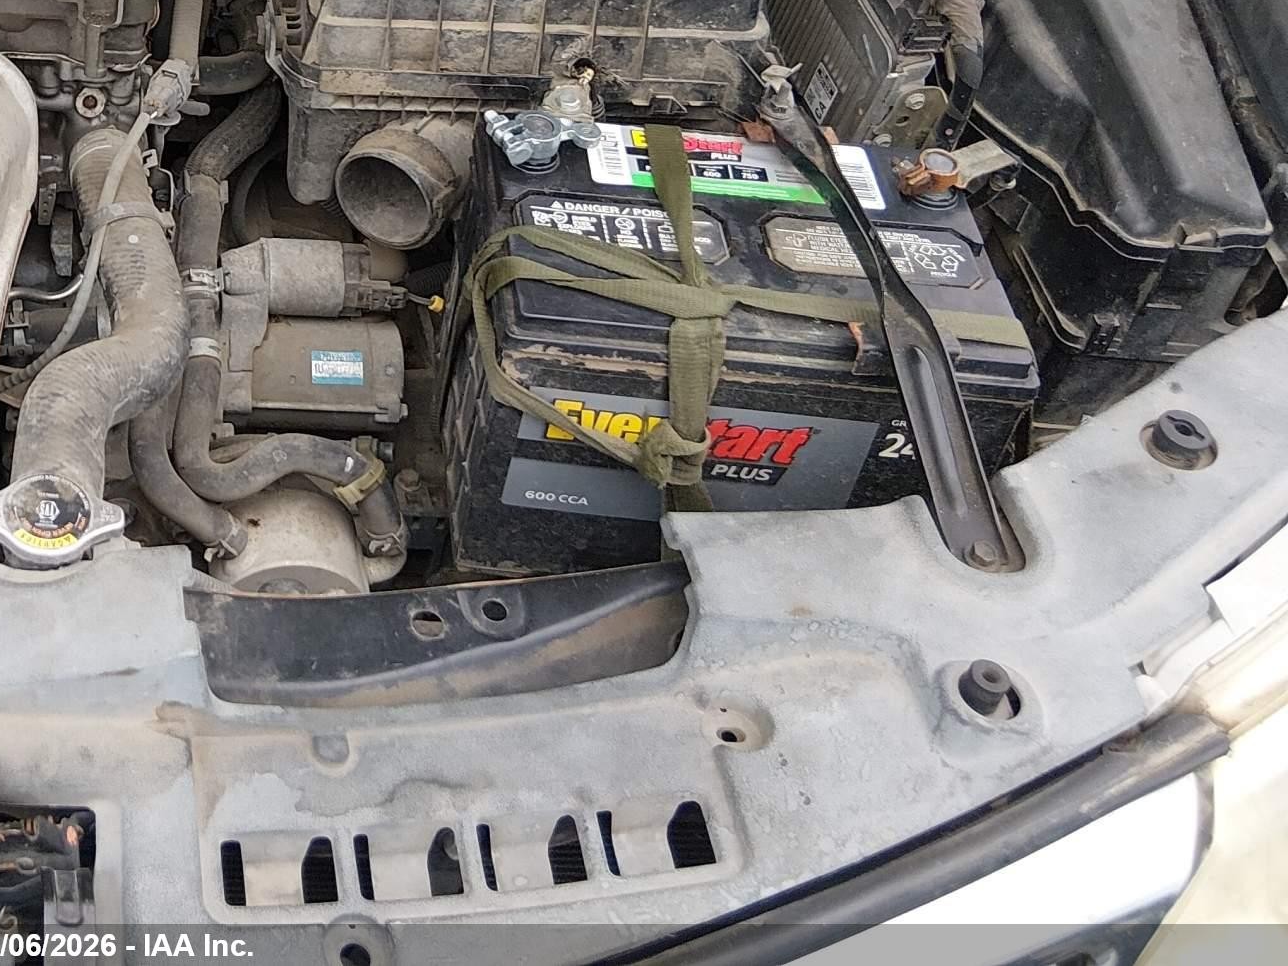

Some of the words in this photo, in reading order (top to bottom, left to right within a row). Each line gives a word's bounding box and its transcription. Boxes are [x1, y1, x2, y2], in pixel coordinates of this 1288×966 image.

[710, 153, 739, 162] PLUS
[564, 202, 620, 214] DANGER
[711, 464, 774, 482] PLUS
[524, 490, 556, 502] 600
[558, 493, 590, 506] CCA
